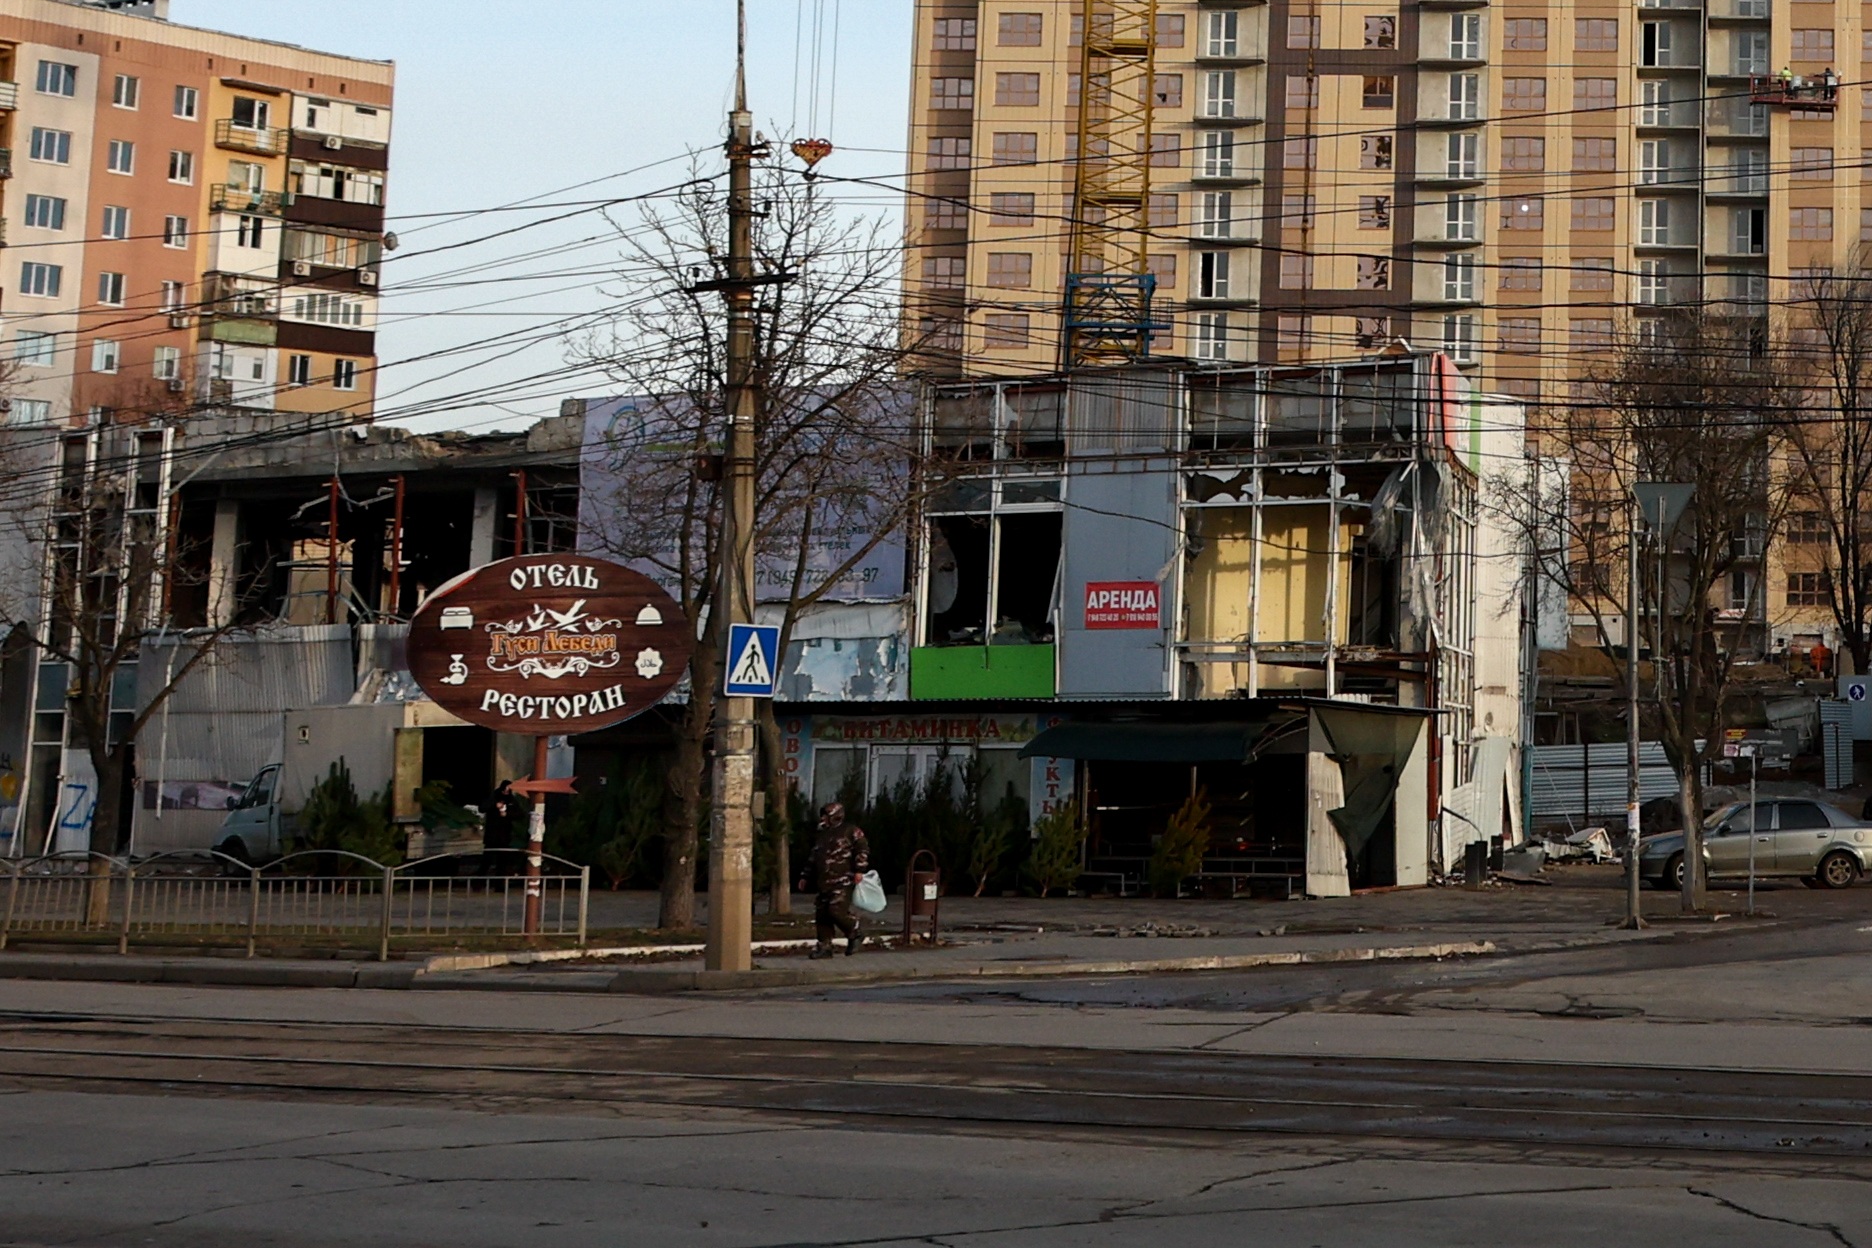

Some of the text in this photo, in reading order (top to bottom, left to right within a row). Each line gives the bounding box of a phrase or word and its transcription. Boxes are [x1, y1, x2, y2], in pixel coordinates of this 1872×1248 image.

[510, 563, 600, 591] ОТЕЛЬ
[1087, 590, 1157, 611] АРЕНДА
[490, 629, 617, 661] Гуси Лебеди
[480, 684, 627, 719] РЕСТОРАН
[843, 718, 1001, 738] ВИТАМИНКА
